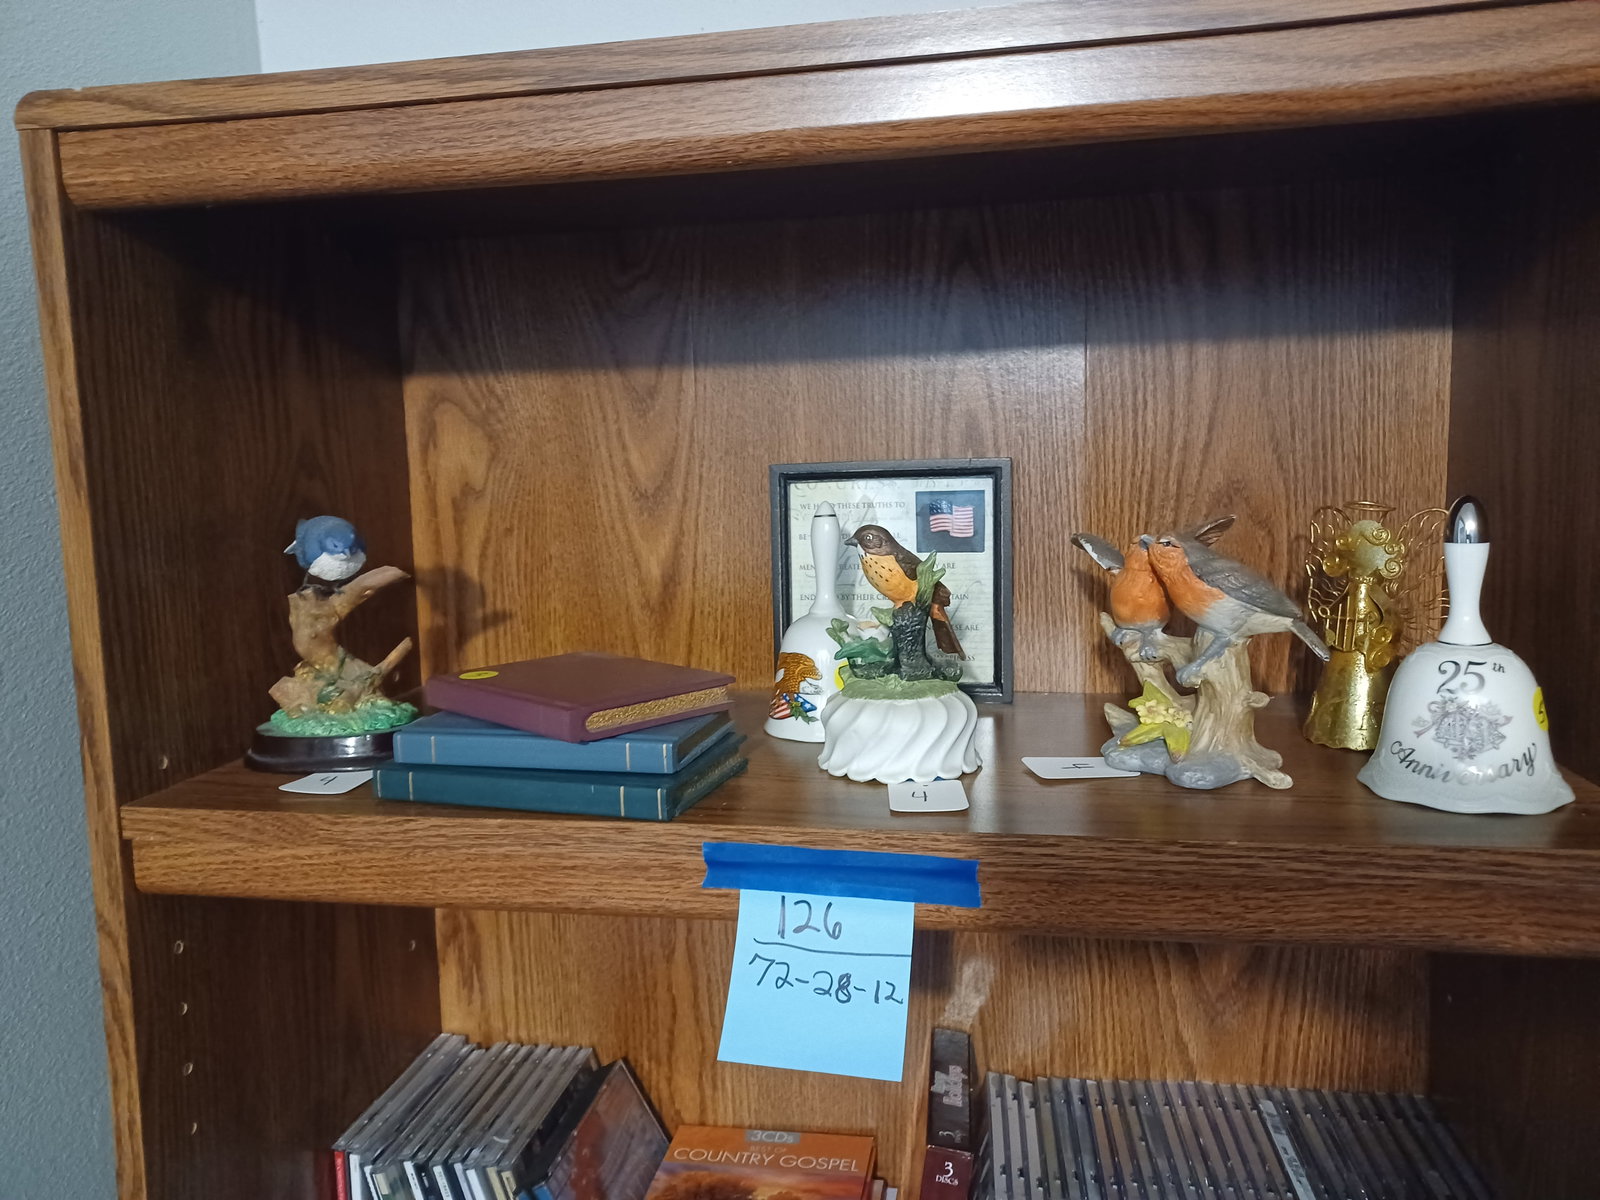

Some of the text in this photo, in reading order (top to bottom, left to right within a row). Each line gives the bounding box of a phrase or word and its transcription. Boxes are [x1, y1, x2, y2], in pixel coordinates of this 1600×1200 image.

[837, 501, 861, 509] THESE
[861, 501, 893, 509] TRUTHS
[851, 593, 875, 601] THEIR
[964, 624, 980, 632] ARE
[777, 894, 843, 940] 126
[749, 1130, 795, 1144] 3CDs
[749, 1145, 773, 1154] BEST
[672, 1148, 860, 1173] COUNTRY GOSPEL
[944, 1161, 954, 1178] 3
[935, 1174, 959, 1187] DISCS
